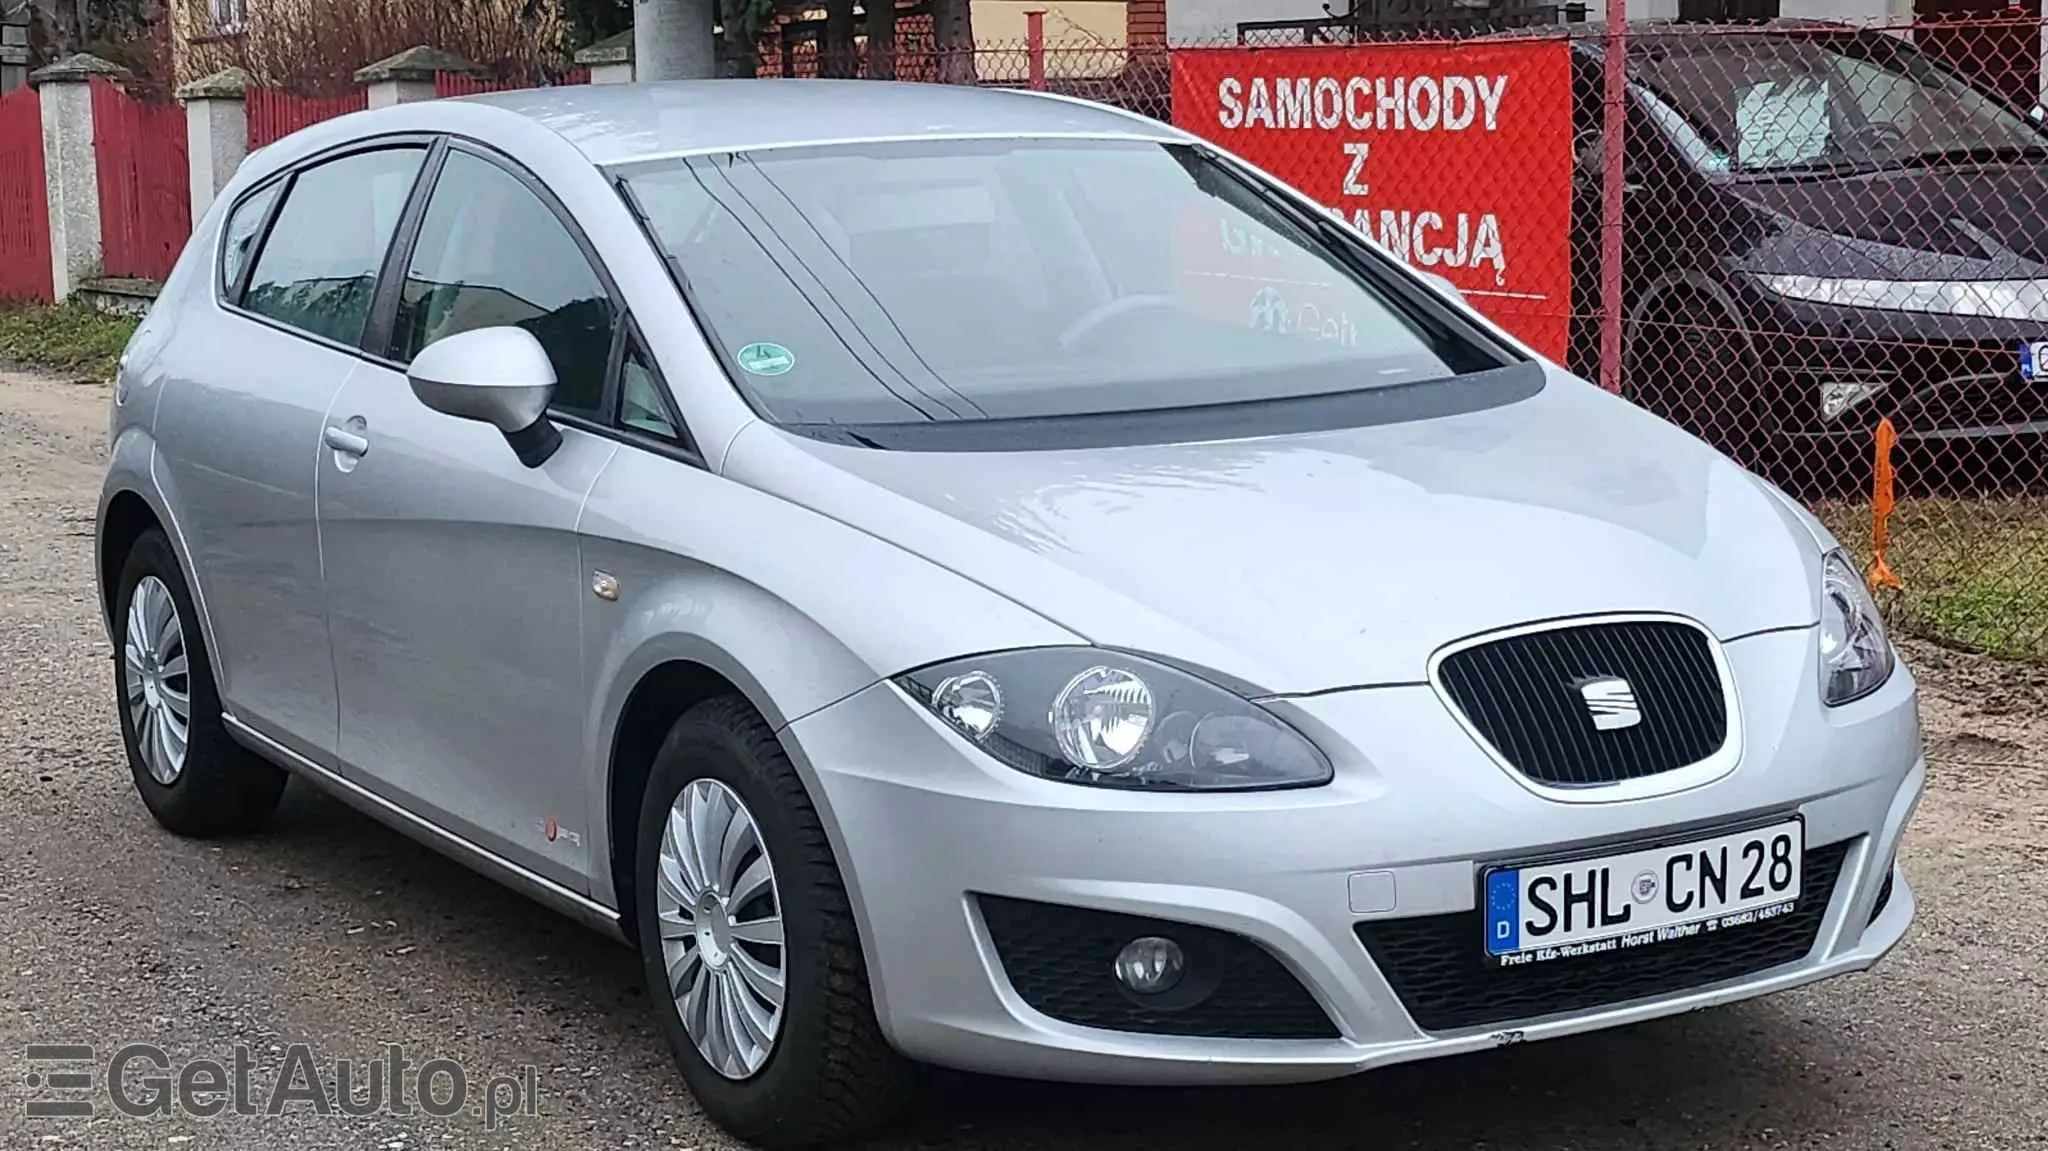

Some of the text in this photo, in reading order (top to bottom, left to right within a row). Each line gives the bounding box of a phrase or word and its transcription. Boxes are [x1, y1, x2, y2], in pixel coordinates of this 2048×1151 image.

[1218, 74, 1509, 131] SAMOCHODY
[1342, 143, 1369, 196] Z
[1525, 834, 1793, 937] SHL CN 28
[1496, 920, 1510, 939] D
[1500, 951, 1533, 967] Freie
[1621, 931, 1655, 949] Horst
